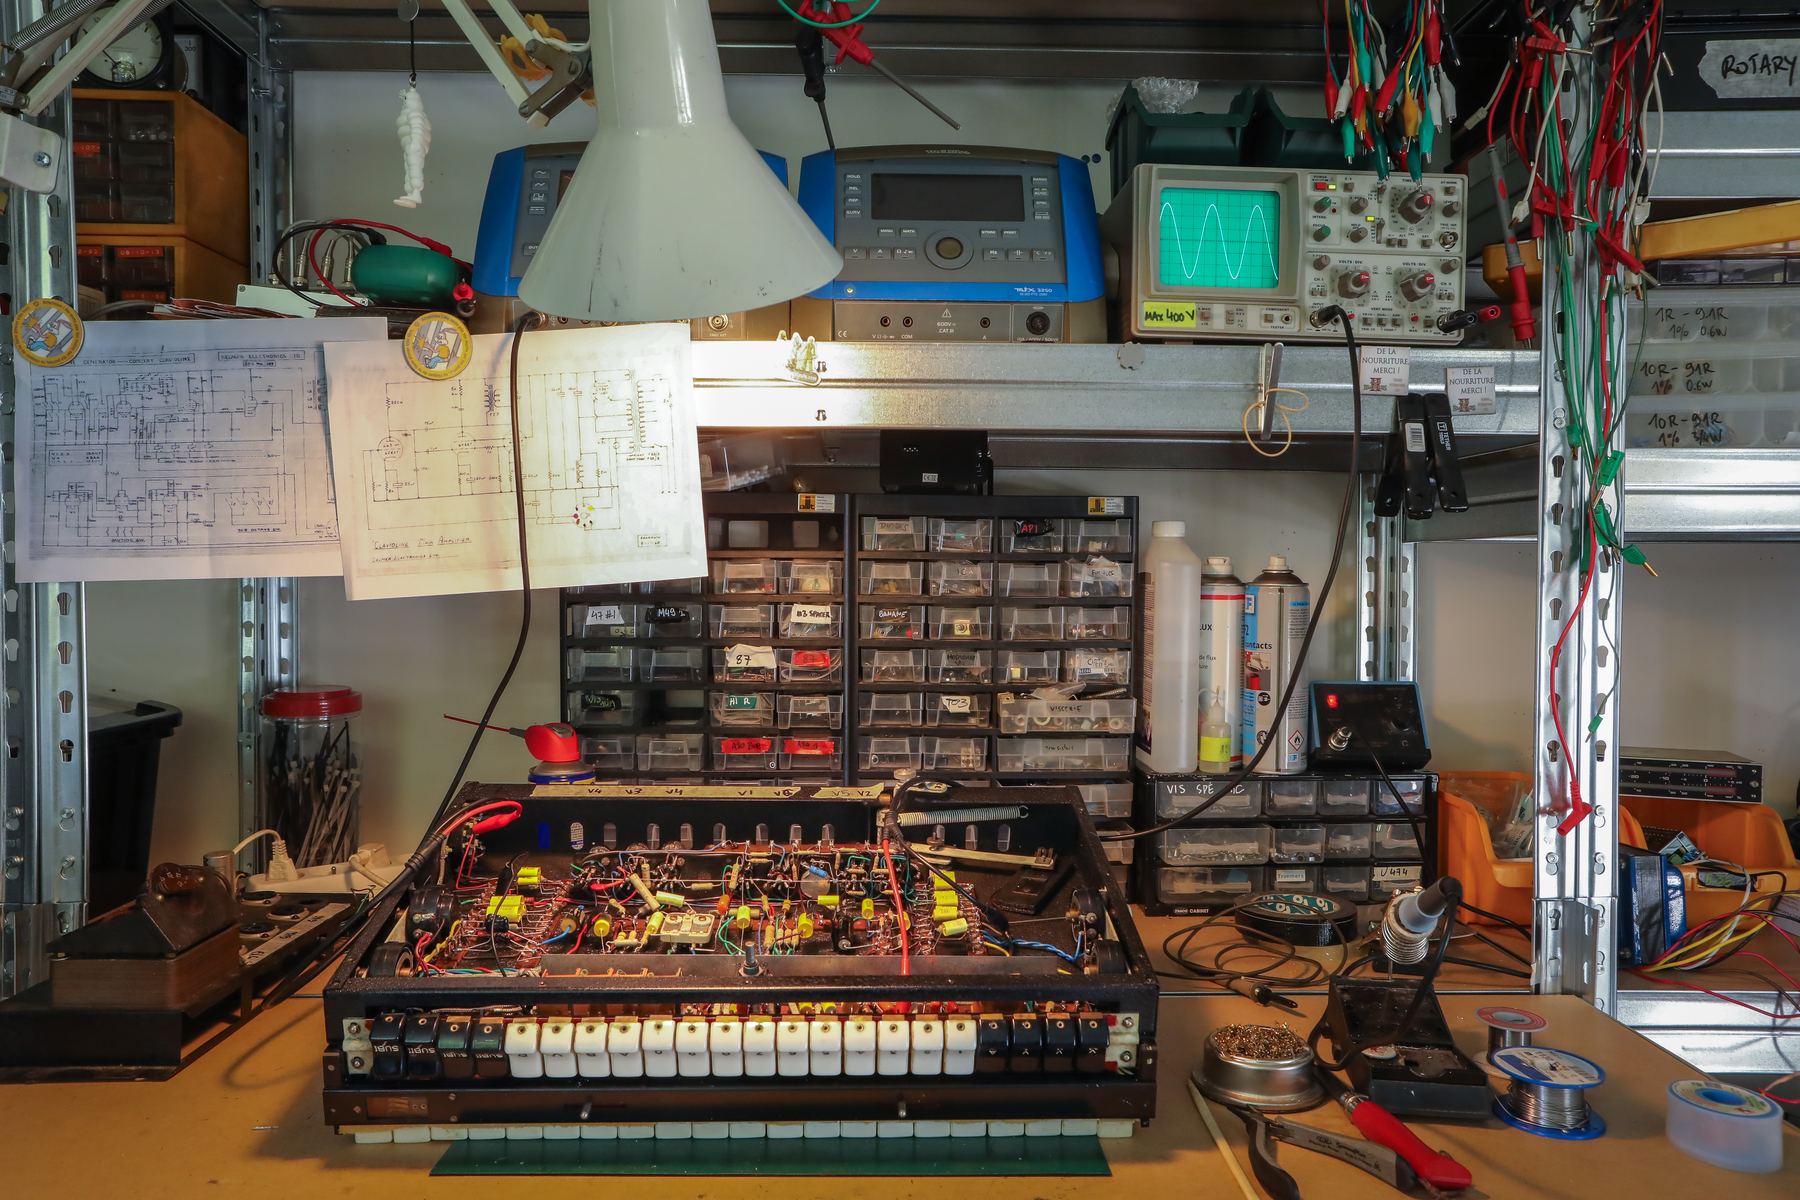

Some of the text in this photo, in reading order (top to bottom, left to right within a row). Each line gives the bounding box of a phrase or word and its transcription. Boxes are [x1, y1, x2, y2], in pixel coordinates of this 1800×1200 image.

[1721, 52, 1797, 86] ROTARY
[1167, 310, 1184, 322] 400
[1185, 310, 1195, 320] V
[1655, 307, 1674, 322] 1R
[1695, 307, 1729, 324] 9.1R
[1669, 324, 1728, 341] 1% 0.6W
[1640, 362, 1670, 377] 10R
[1685, 362, 1715, 377] 91R
[1652, 380, 1672, 395] 1%
[1648, 413, 1678, 429] 10R
[1691, 412, 1722, 427] 91R
[1443, 432, 1451, 451] TETHER
[1659, 431, 1722, 447] 1% 3/4W
[1021, 524, 1038, 533] API
[658, 607, 676, 617] M49
[809, 610, 832, 618] SPACER
[736, 654, 751, 665] 87
[1166, 781, 1214, 794] VIS SPÉ
